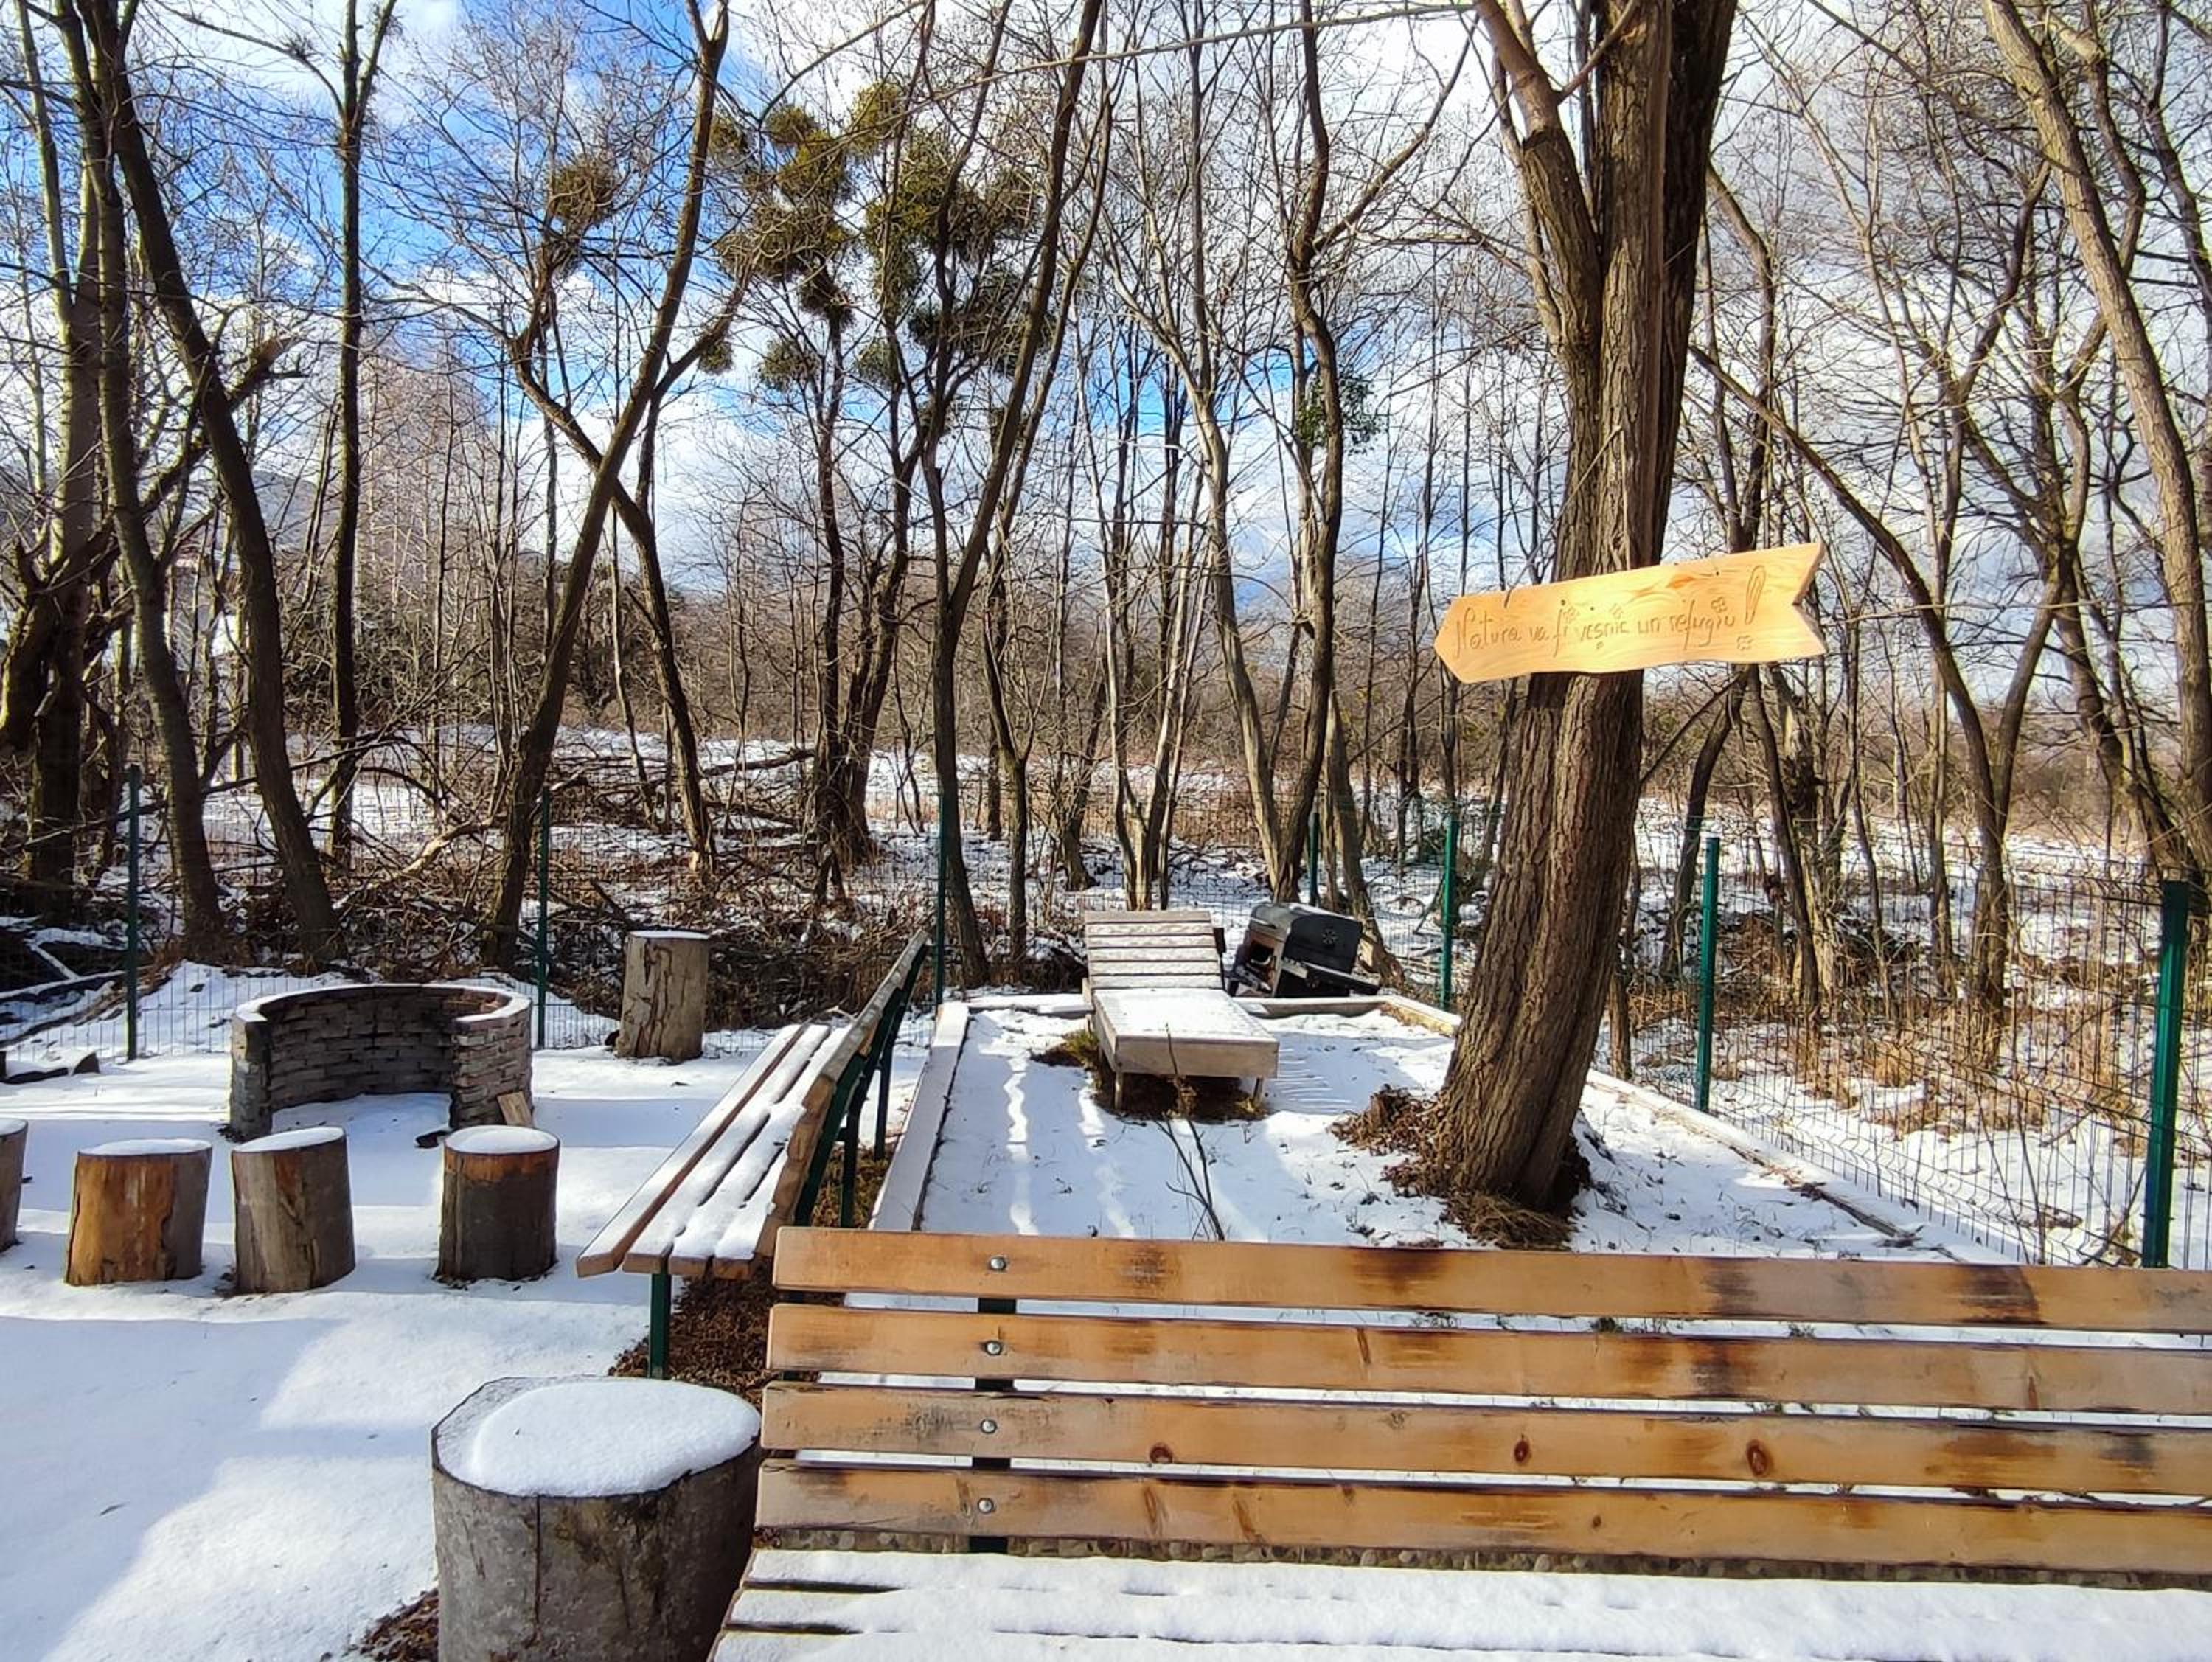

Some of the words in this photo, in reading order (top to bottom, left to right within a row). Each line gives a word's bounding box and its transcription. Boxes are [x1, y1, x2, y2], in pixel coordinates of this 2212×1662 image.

[1455, 607, 1521, 659] Natura
[1529, 626, 1549, 641] va
[1552, 606, 1570, 658] fi
[1638, 617, 1660, 633] un
